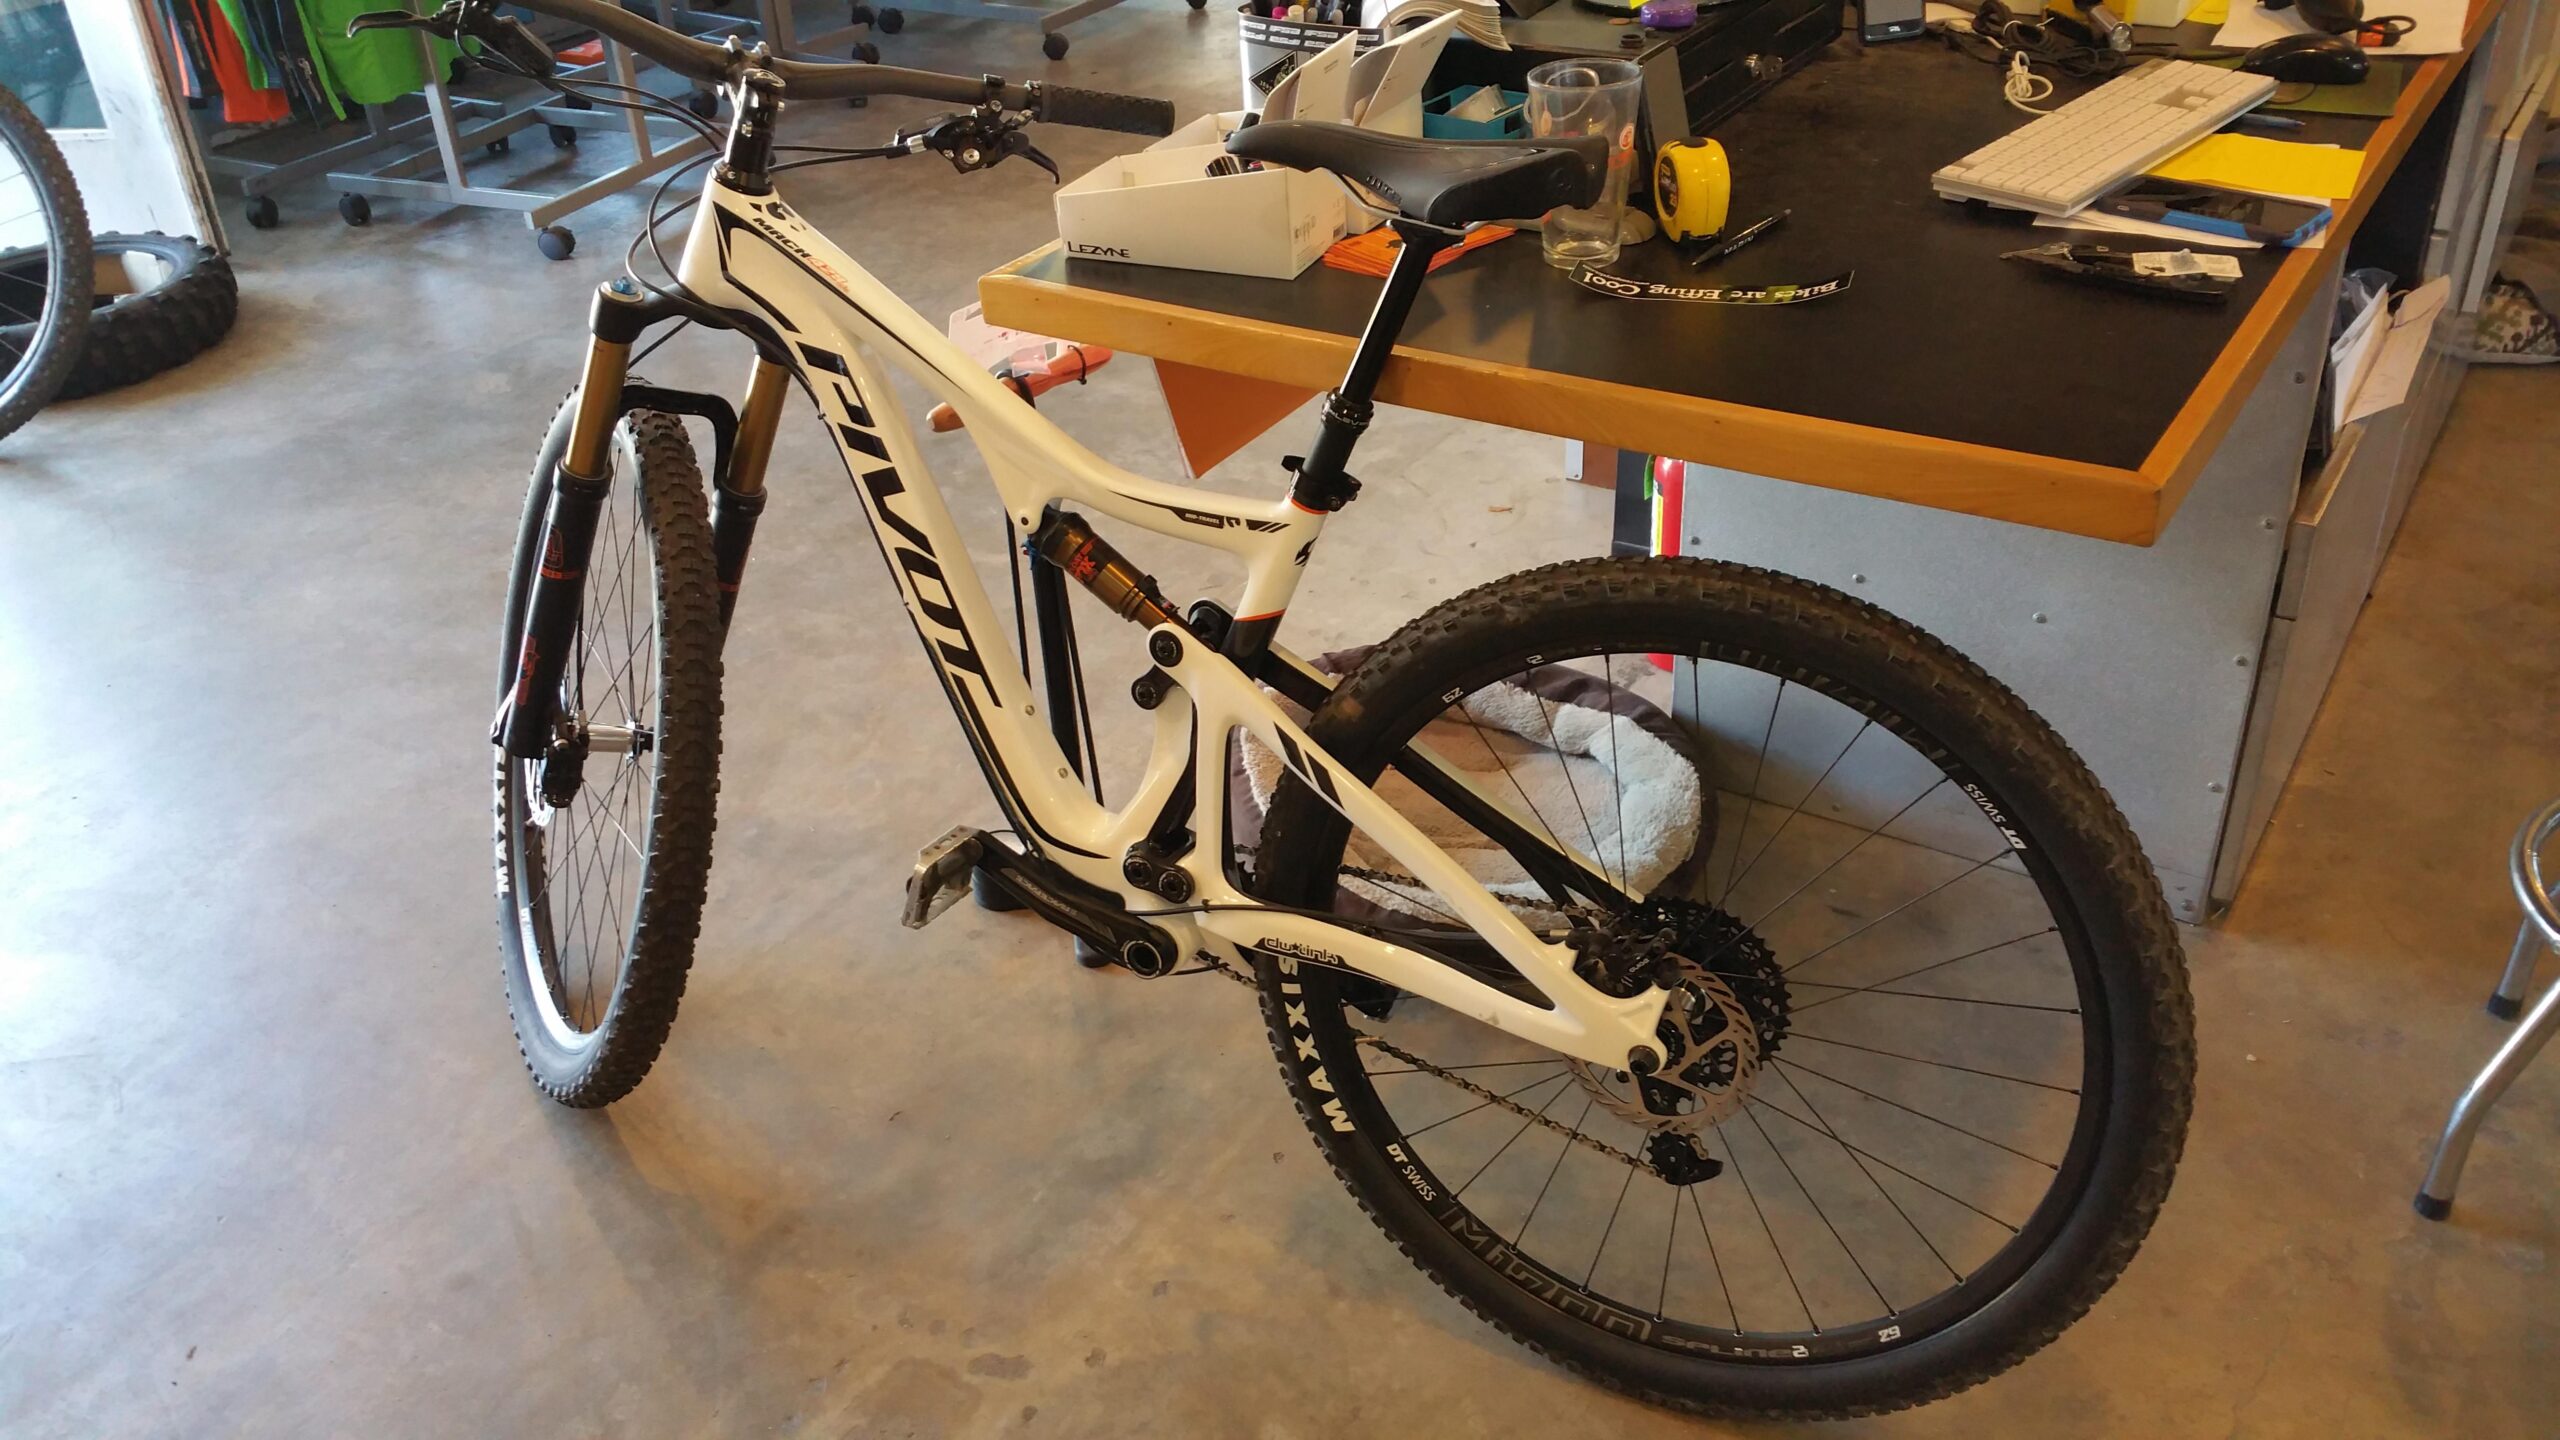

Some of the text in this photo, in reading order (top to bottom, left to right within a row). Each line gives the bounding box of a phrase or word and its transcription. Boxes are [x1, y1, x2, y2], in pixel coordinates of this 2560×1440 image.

[752, 217, 812, 258] MACH
[1066, 240, 1131, 259] LEZYNE
[1583, 271, 1641, 295] Cool
[1647, 284, 1724, 300] Effing
[1774, 279, 1839, 299] Bikes
[1729, 290, 1767, 299] are
[795, 341, 1003, 708] PIVOT
[1441, 687, 1464, 704] 29
[1963, 783, 2028, 849] DT SWISS
[1278, 954, 1356, 1132] MAXXIS
[1386, 1143, 1437, 1201] DT SWISS
[1878, 1325, 1902, 1343] 29
